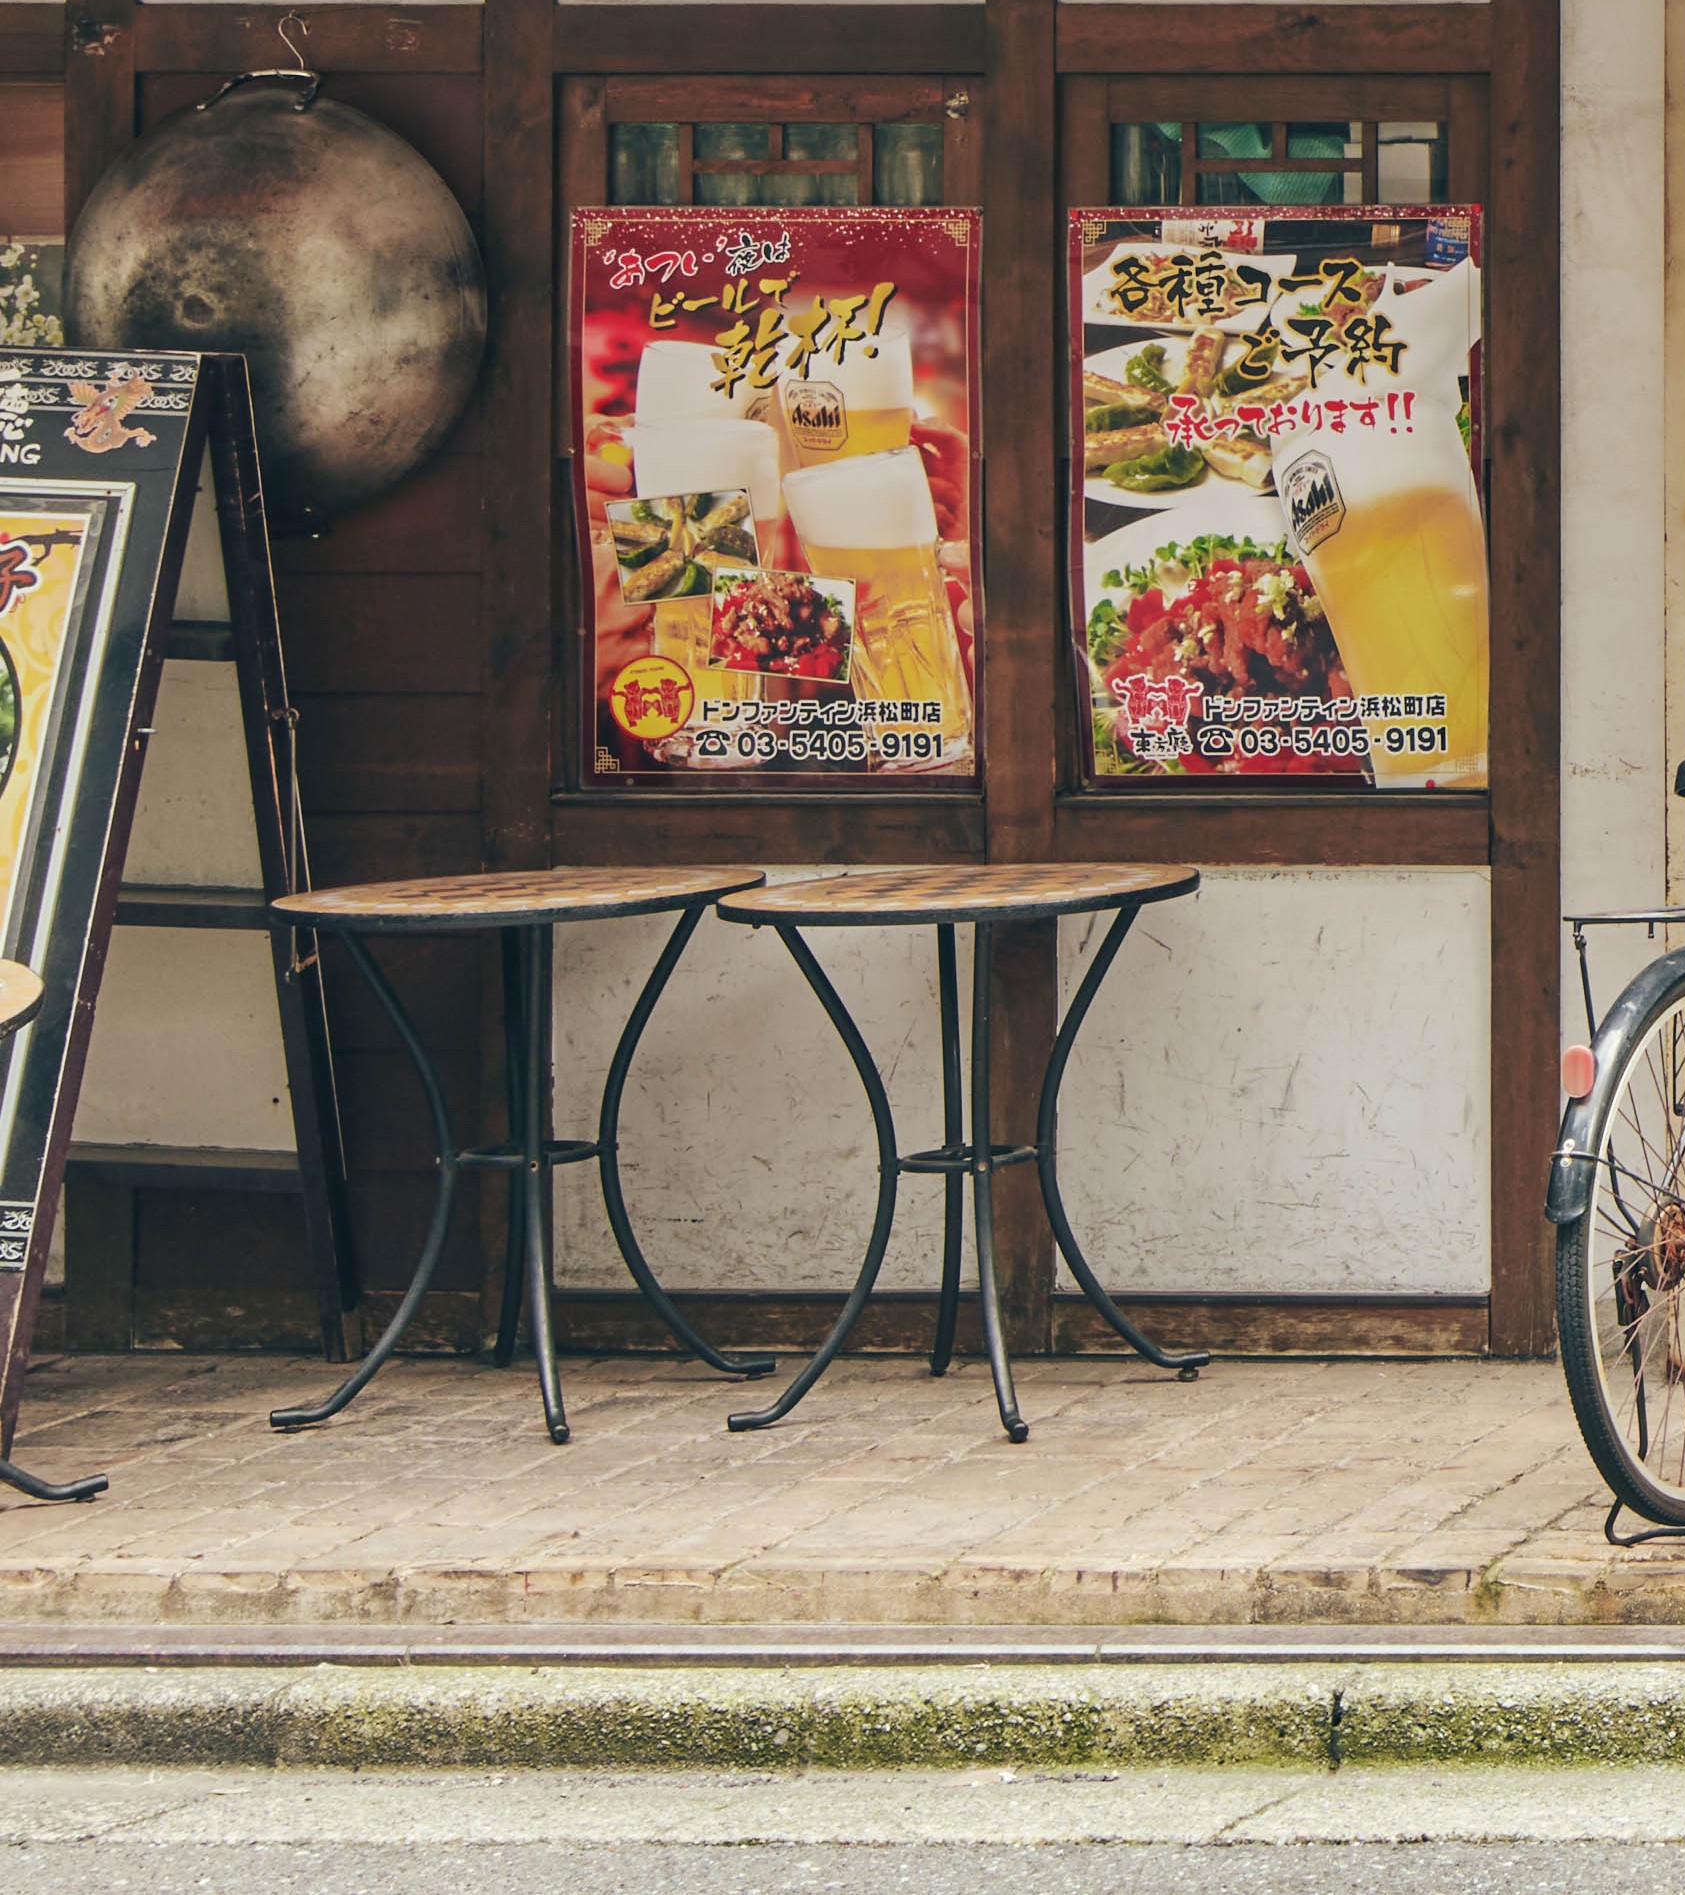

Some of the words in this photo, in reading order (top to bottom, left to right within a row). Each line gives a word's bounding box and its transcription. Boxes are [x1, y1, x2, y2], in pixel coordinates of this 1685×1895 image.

[649, 270, 798, 328] ビールで
[1109, 253, 1365, 316] 各種コース
[710, 281, 896, 398] 乾杯!
[1238, 316, 1409, 388] ご予約
[792, 404, 841, 428] Asahi
[1165, 391, 1416, 450] 承っております!!
[1292, 472, 1335, 532] Asahi
[701, 699, 942, 725] ドンファンティン浜松町店
[1203, 695, 1446, 721] ドンファンティン浜松町店
[737, 732, 943, 760] 03-5405-9191
[1241, 726, 1447, 755] 03-5405-9191
